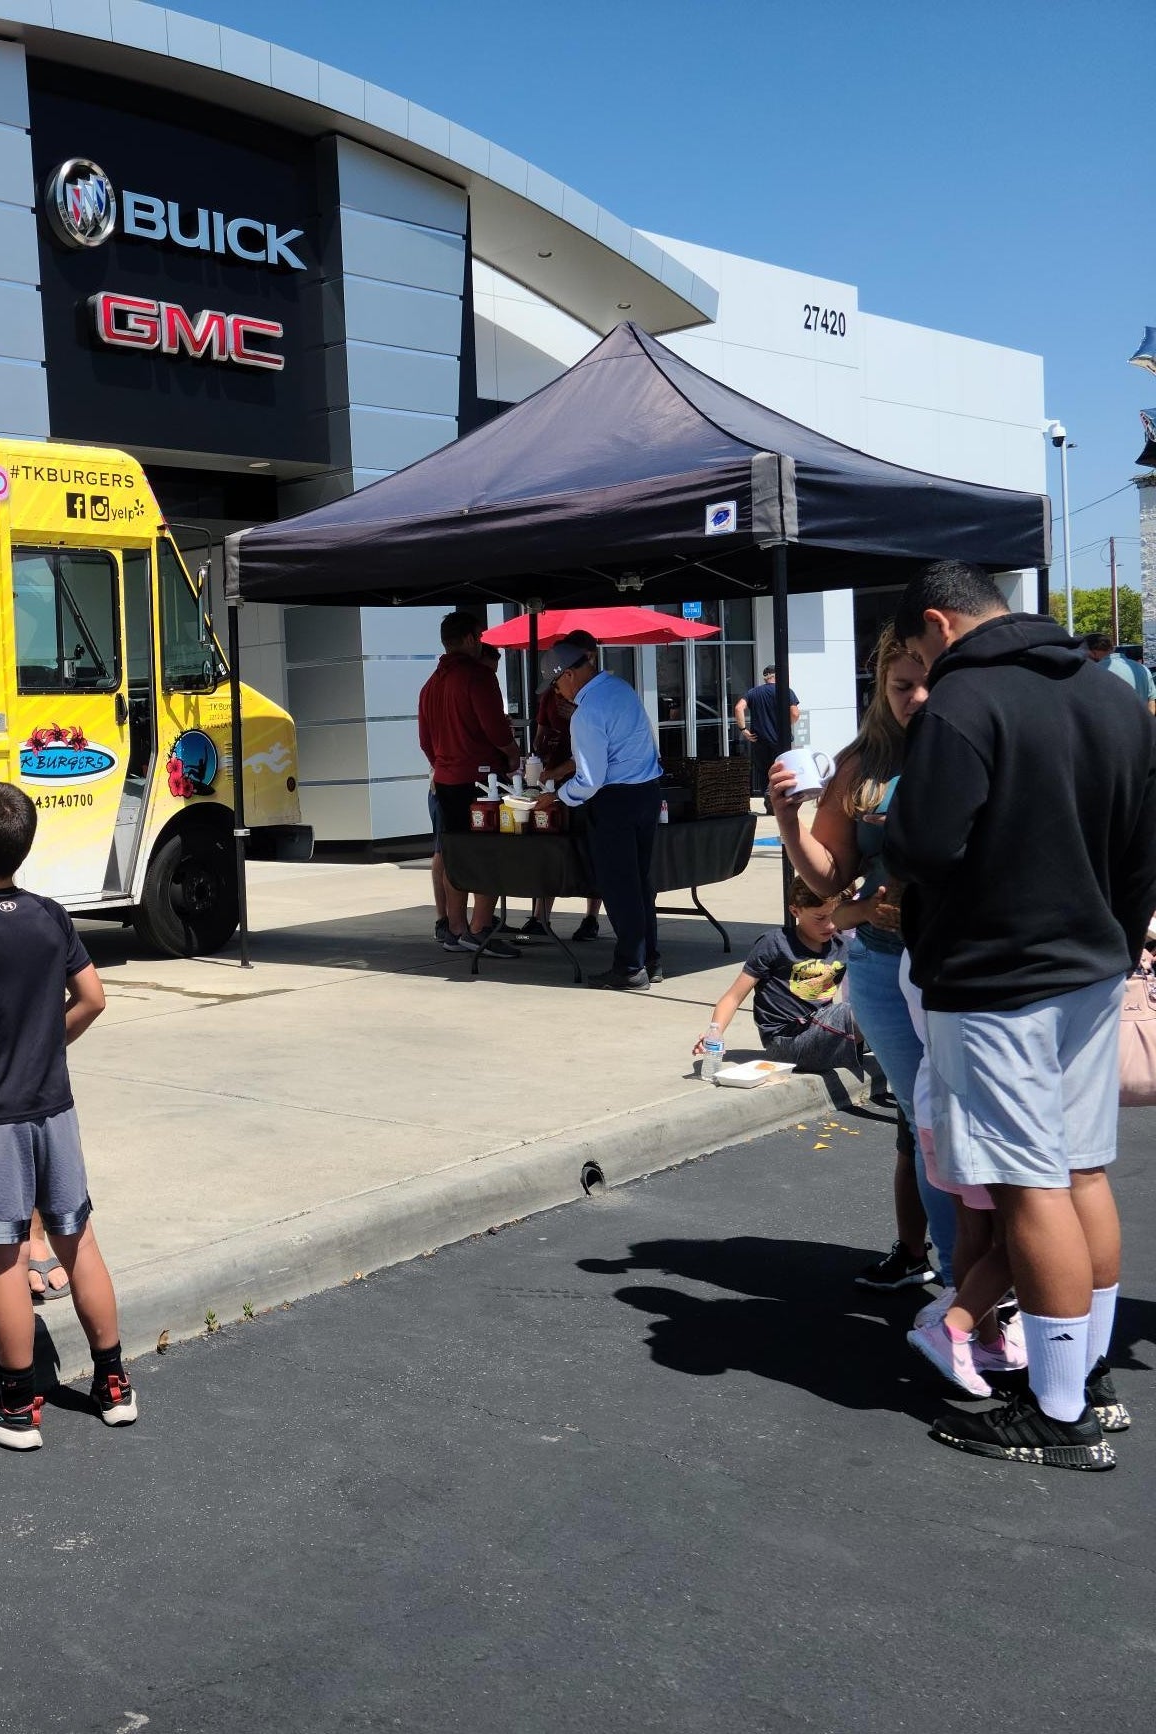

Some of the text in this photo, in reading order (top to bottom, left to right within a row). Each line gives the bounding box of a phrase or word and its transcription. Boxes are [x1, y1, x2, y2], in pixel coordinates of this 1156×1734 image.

[122, 190, 308, 270] BUICK
[92, 291, 285, 371] GMC
[803, 304, 846, 337] 27420
[10, 465, 135, 488] #TKBURGERS
[111, 506, 135, 522] yelp
[20, 755, 104, 771] K BURGERS
